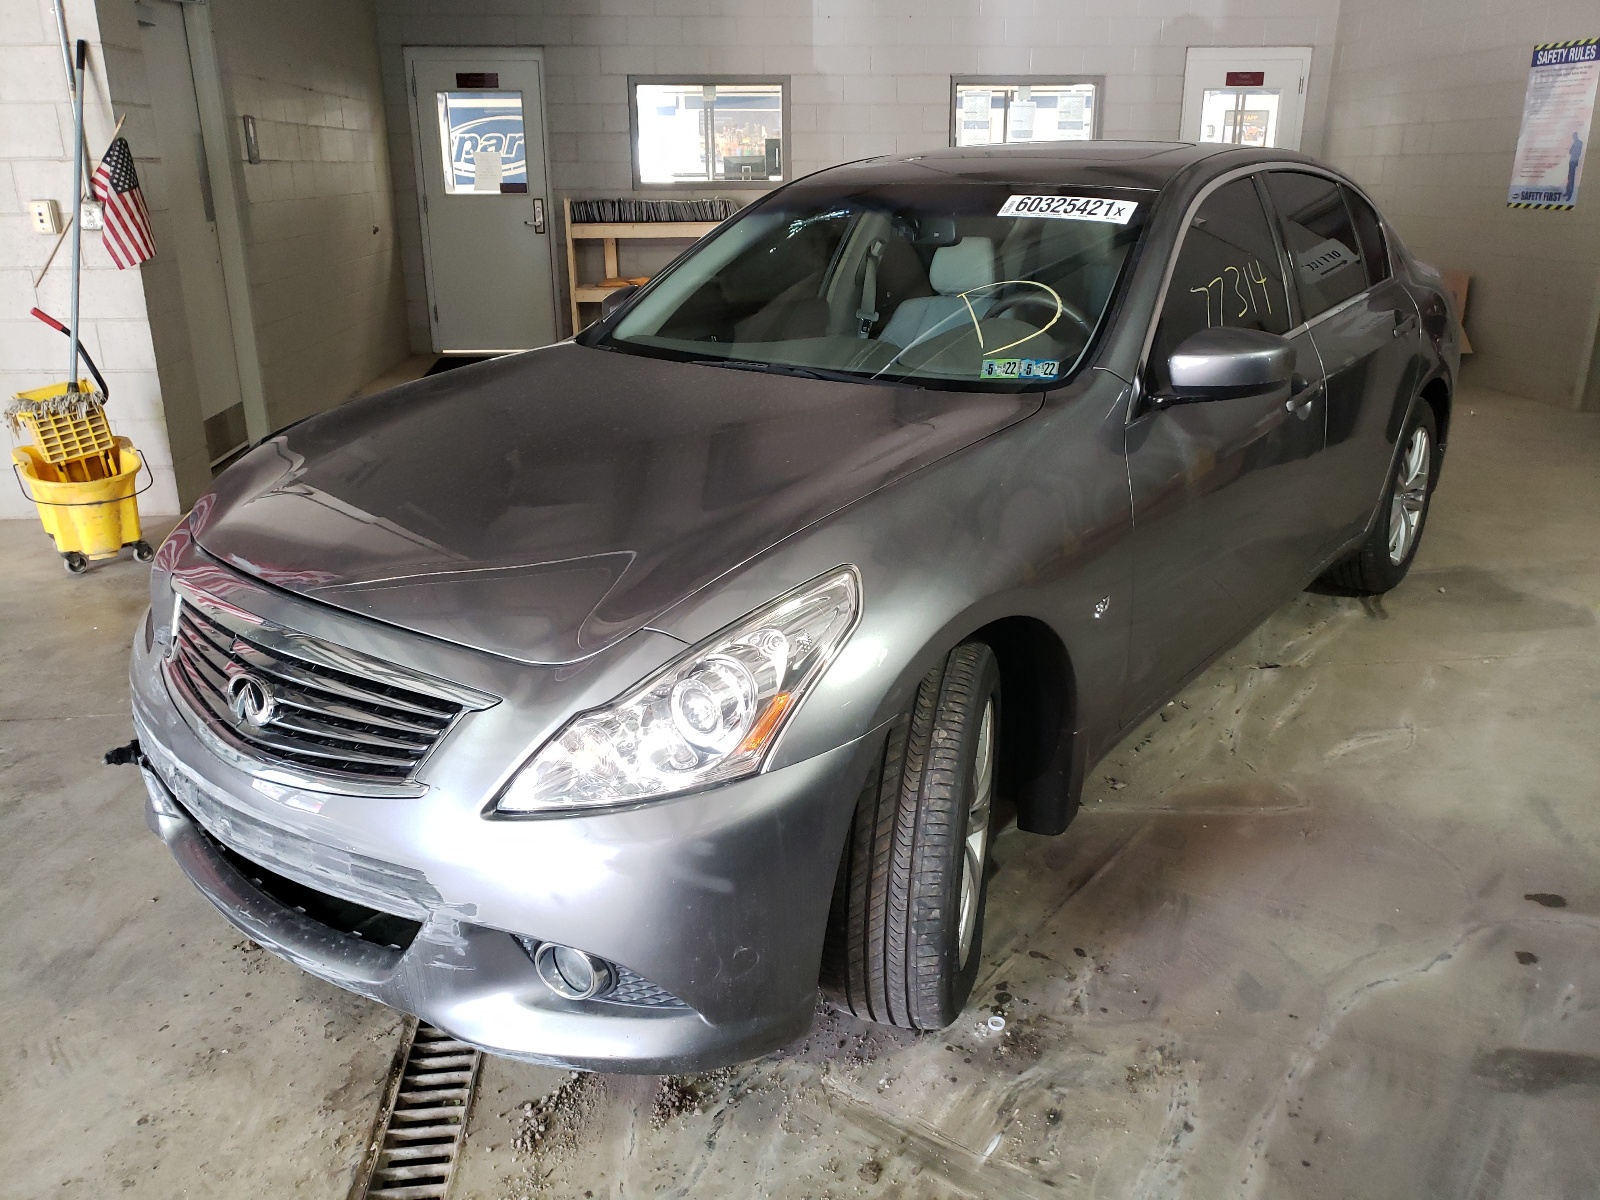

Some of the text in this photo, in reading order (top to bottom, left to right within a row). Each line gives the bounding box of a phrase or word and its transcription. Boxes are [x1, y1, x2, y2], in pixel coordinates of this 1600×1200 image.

[1537, 45, 1597, 64] SAFETY RULES
[1521, 190, 1562, 202] SAFETY FIRST
[1190, 260, 1271, 328] 77314
[1004, 362, 1017, 375] 22
[1043, 362, 1056, 376] 22
